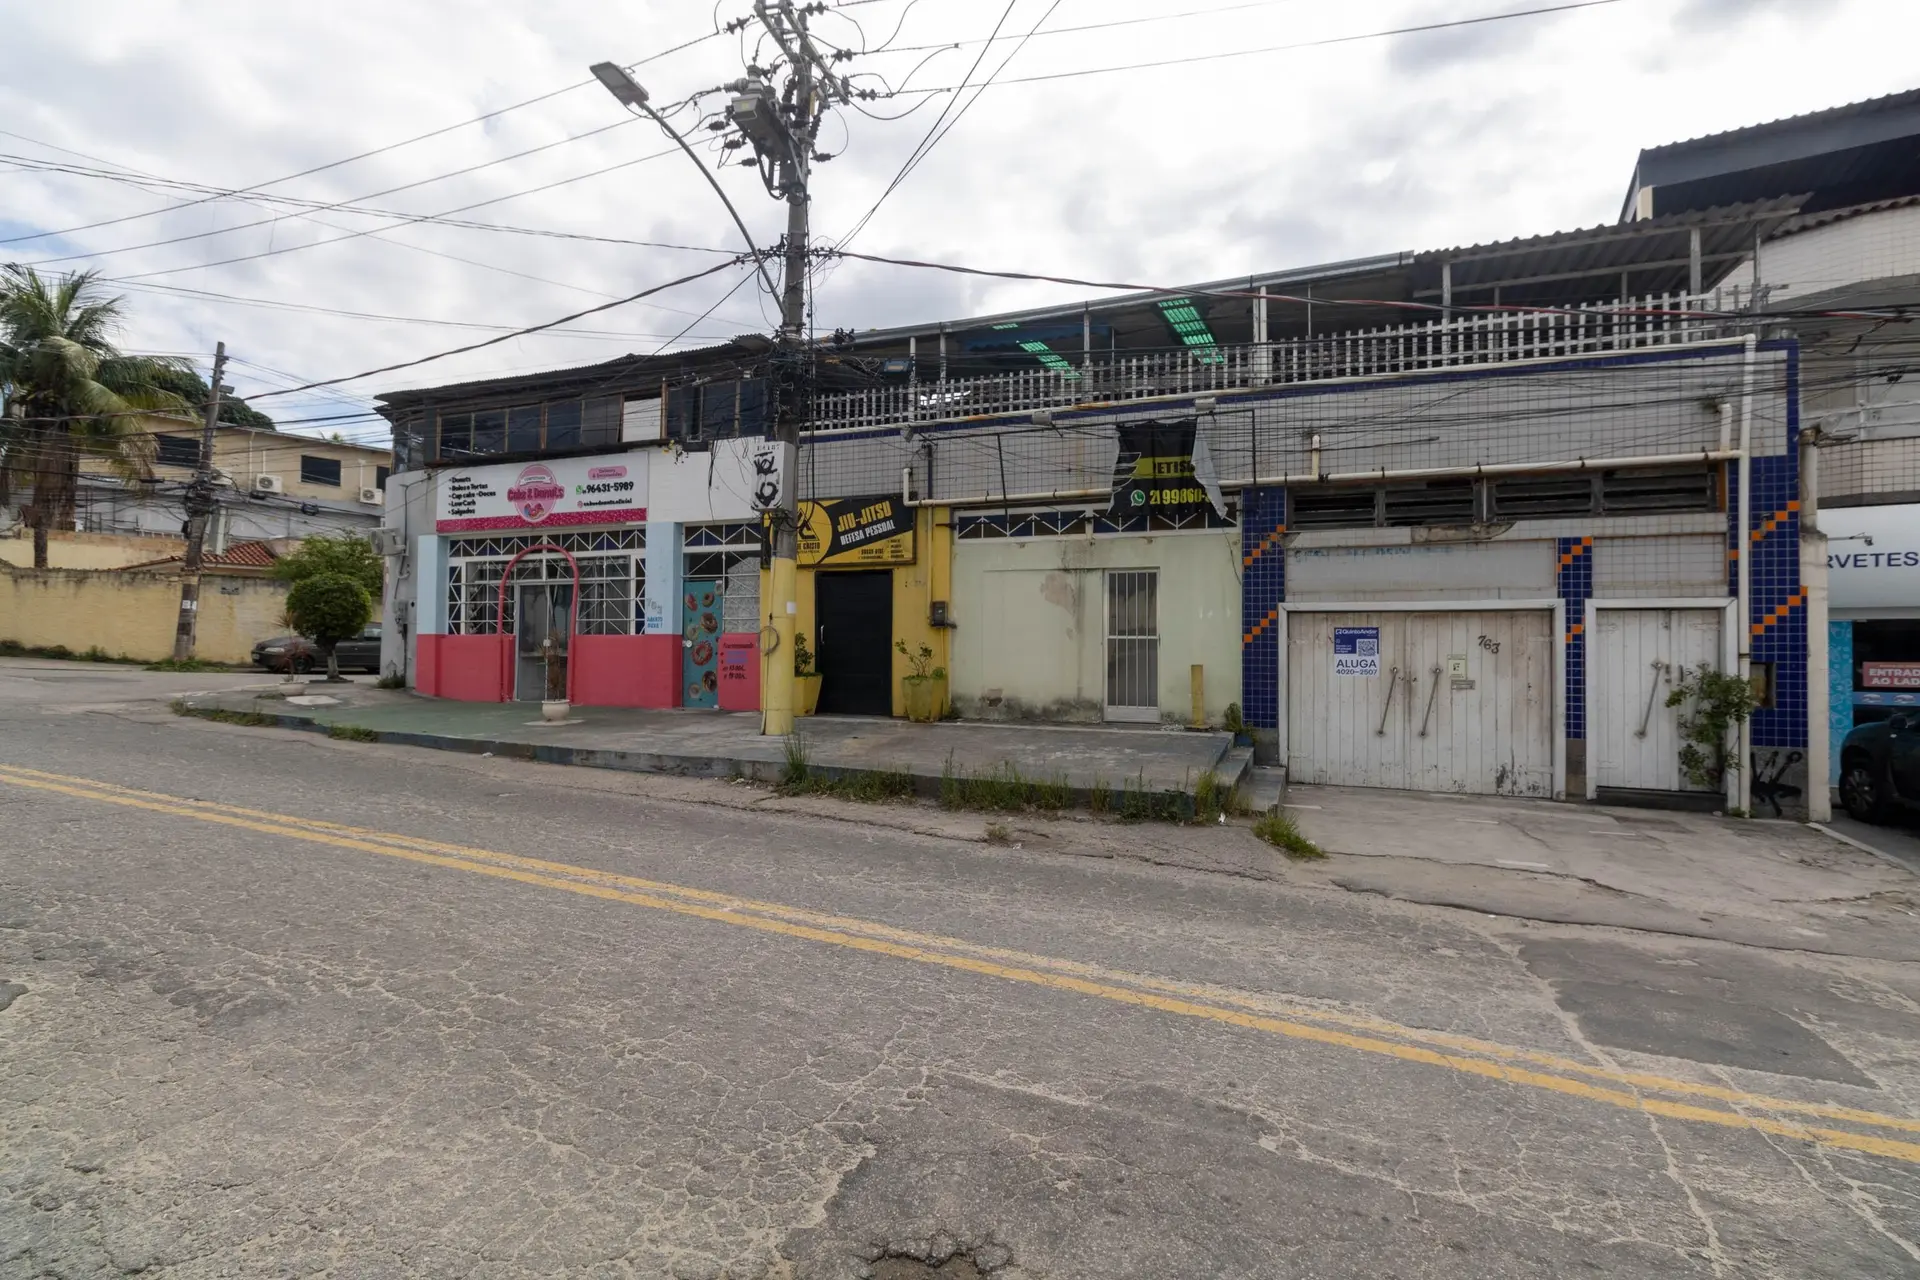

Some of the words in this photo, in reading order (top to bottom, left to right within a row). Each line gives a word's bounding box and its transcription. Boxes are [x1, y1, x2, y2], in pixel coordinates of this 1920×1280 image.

[450, 507, 475, 516] Salgados
[837, 500, 893, 532] JIU-JITSU
[839, 529, 865, 546] DEFESA
[864, 519, 896, 538] PESSOAL
[803, 542, 821, 550] CRISTO
[1478, 634, 1501, 655] 763
[1336, 659, 1377, 668] ALUGA
[1336, 668, 1378, 676] 4020-2507
[1872, 677, 1891, 685] AO
